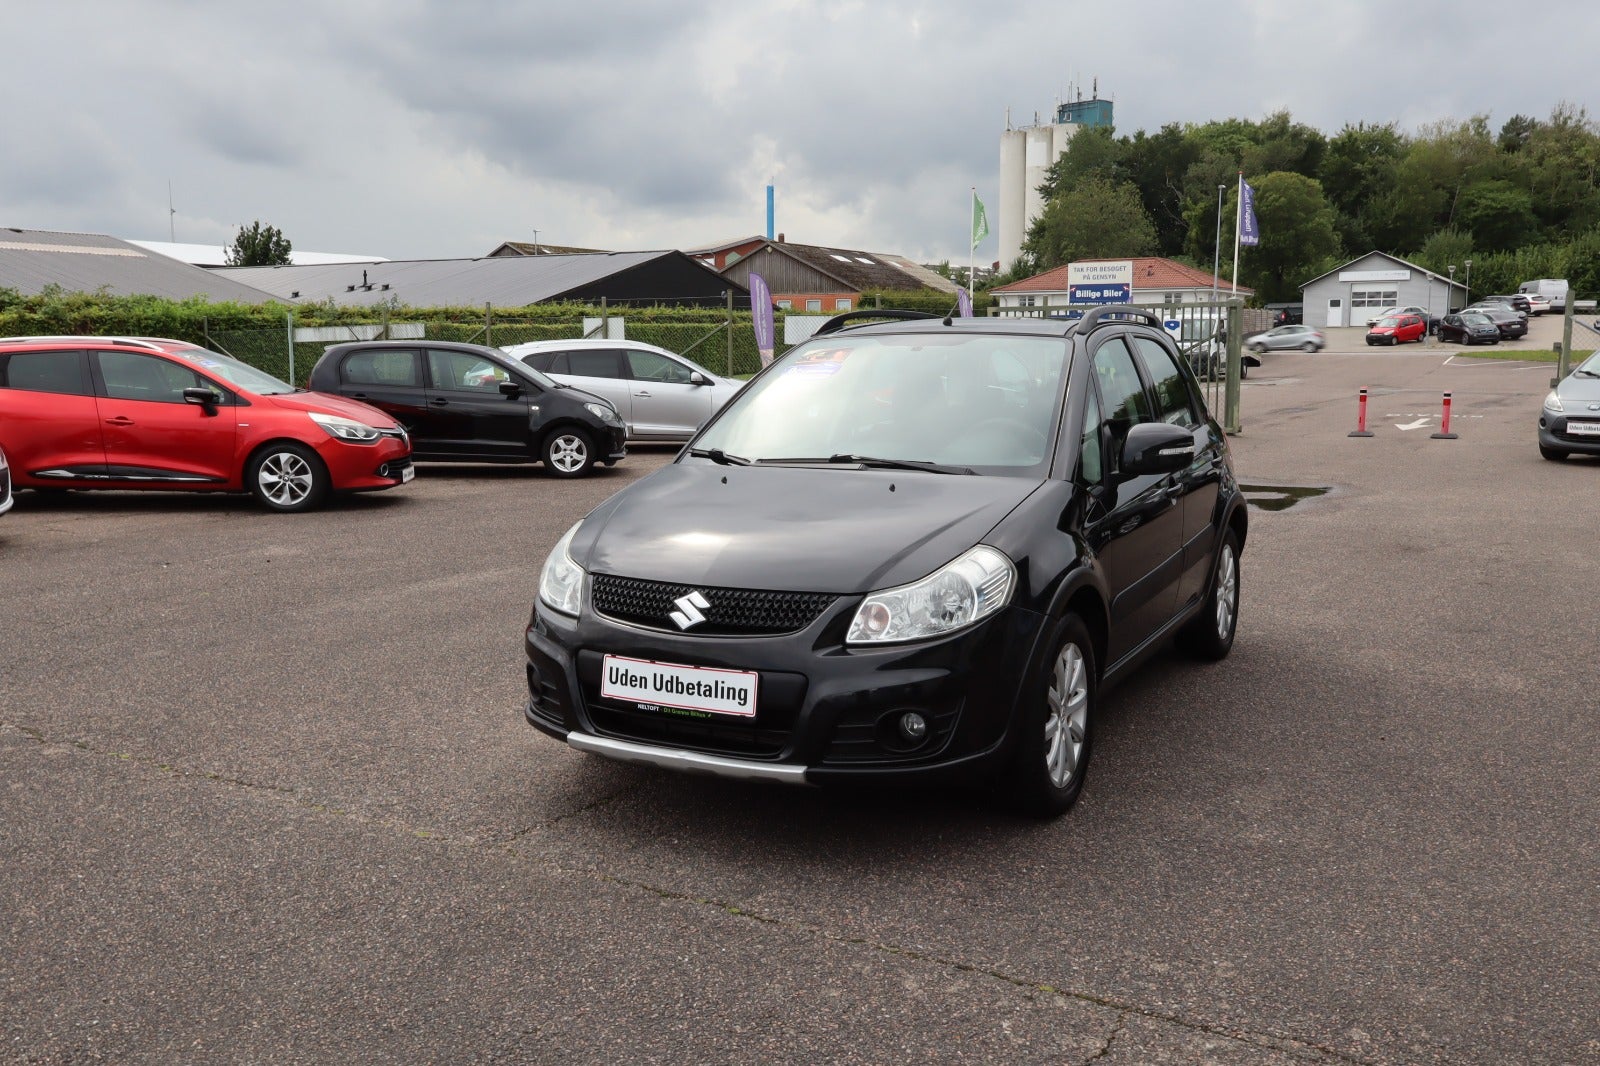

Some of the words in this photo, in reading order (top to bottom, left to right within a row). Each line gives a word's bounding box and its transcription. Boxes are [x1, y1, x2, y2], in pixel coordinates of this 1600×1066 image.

[1075, 289, 1101, 299] Billige
[1103, 289, 1123, 297] Biler
[609, 666, 648, 689] Uden
[653, 672, 748, 706] Udbetaling
[637, 703, 660, 712] NELTOFT
